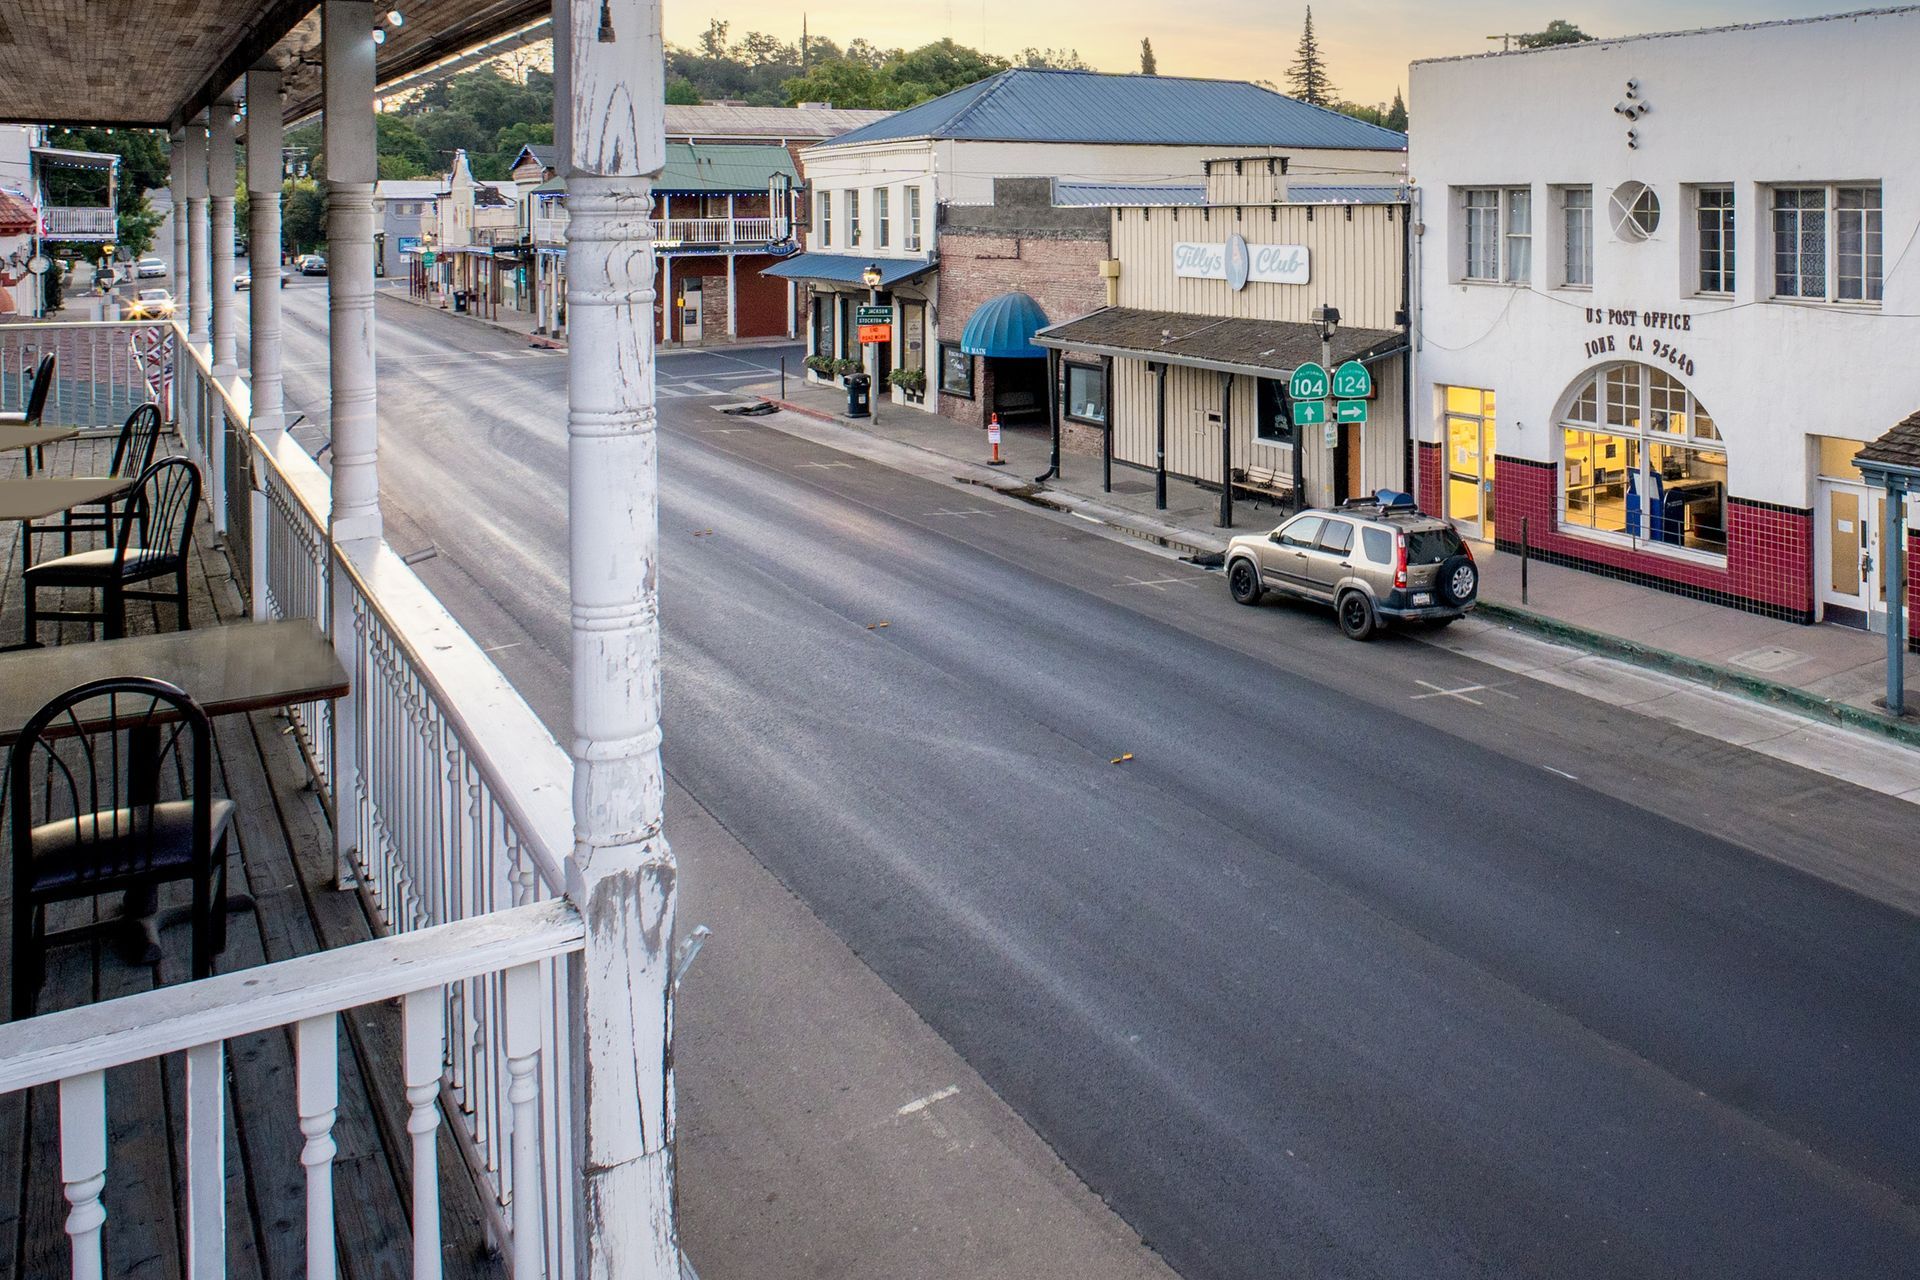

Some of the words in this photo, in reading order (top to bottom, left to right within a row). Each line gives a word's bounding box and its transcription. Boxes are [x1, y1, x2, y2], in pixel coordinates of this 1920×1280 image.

[1176, 245, 1221, 274] Tilly's
[1256, 247, 1304, 273] Club
[1586, 308, 1602, 324] US
[1608, 309, 1637, 327] POST
[1643, 312, 1691, 331] OFFICE
[971, 347, 986, 355] MAIN
[1585, 335, 1616, 359] IONE
[1628, 334, 1643, 352] CA
[1652, 339, 1694, 377] 95640
[1294, 379, 1323, 396] 104
[1338, 376, 1367, 393] 124
